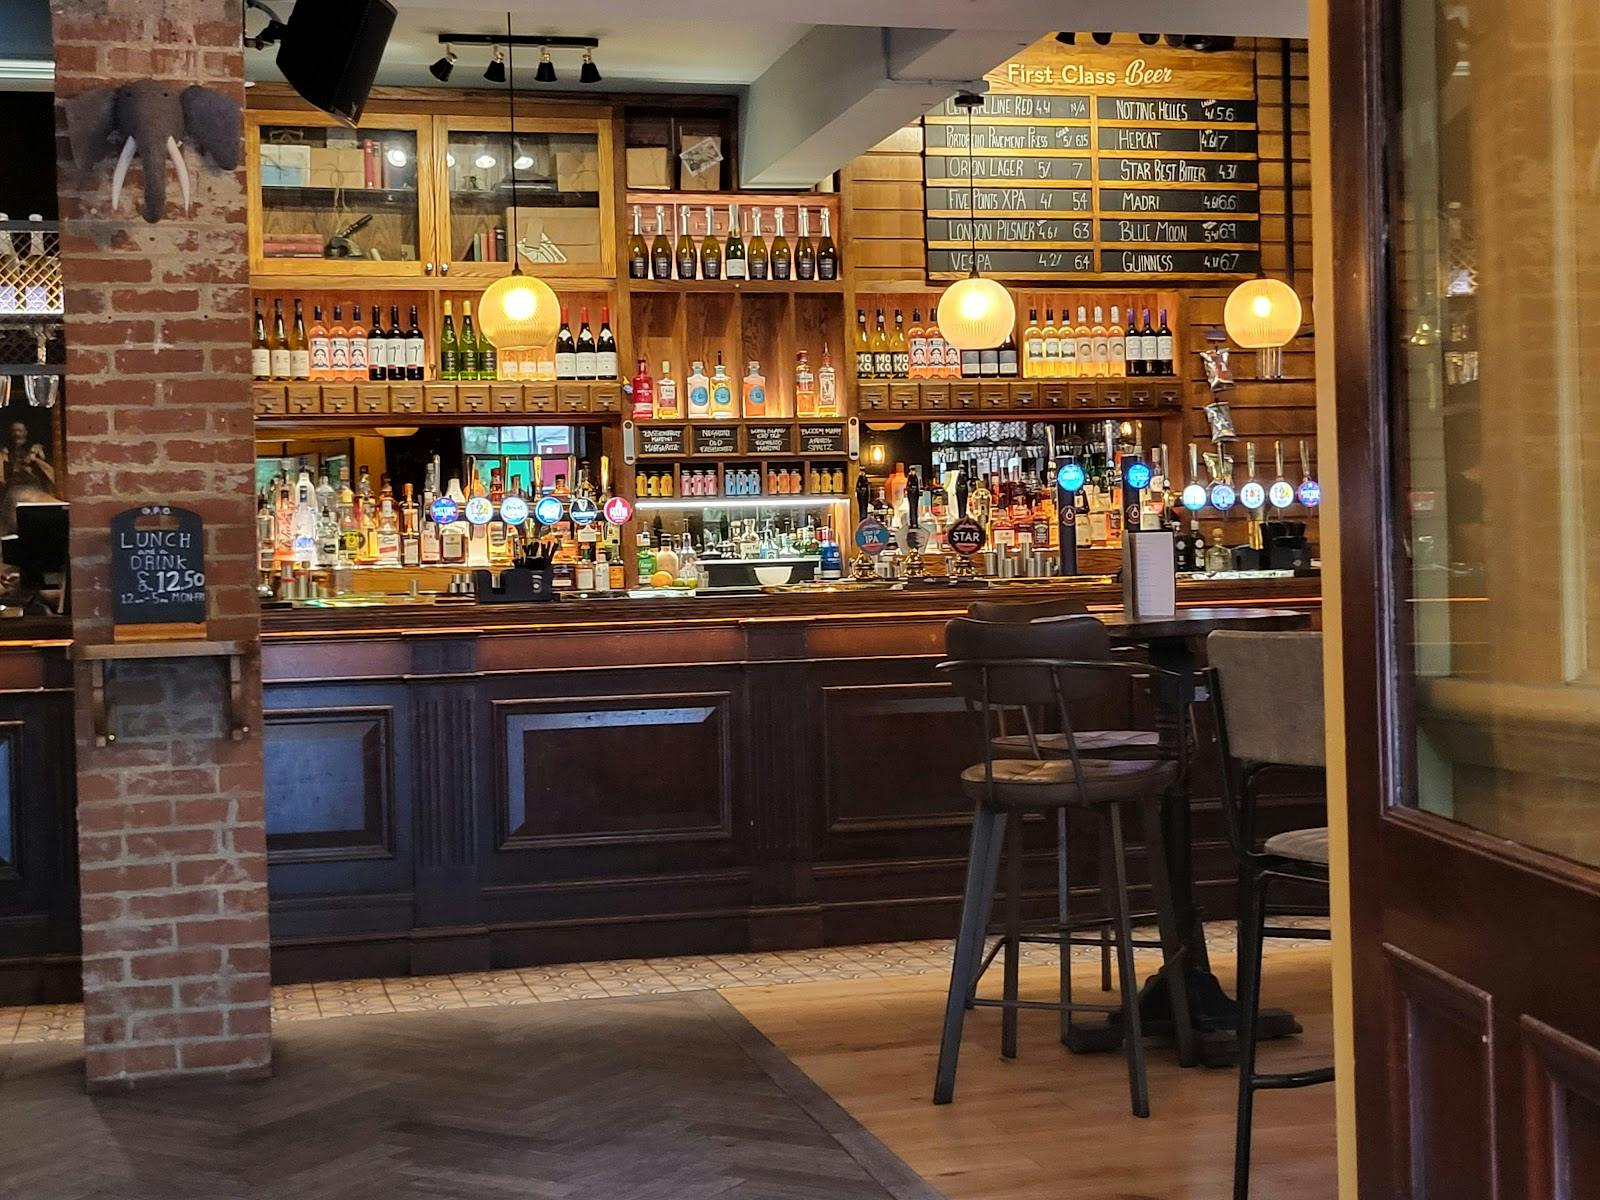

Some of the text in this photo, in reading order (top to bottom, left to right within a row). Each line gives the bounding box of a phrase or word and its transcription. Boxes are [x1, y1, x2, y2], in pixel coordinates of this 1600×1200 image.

[1008, 59, 1173, 86] First Class Beer
[991, 96, 1011, 115] LINE
[1015, 96, 1033, 116] RED
[1070, 100, 1086, 116] N/A
[1116, 99, 1156, 120] NOTTING
[1119, 130, 1161, 150] HEPCAT
[990, 158, 1023, 176] LAGER
[1072, 163, 1082, 179] 7
[1120, 159, 1152, 180] STAR
[1155, 159, 1177, 182] BEST
[949, 189, 969, 209] FIVE
[1002, 190, 1027, 209] XPA
[1122, 192, 1160, 211] MADRI
[949, 220, 992, 241] LONDON
[997, 220, 1035, 240] PILSNER
[1118, 220, 1152, 242] BLUE
[1155, 221, 1188, 242] MOON
[1122, 251, 1174, 272] GUINNESS
[121, 532, 191, 549] LUNCH
[865, 535, 879, 544] IPA
[953, 531, 980, 542] STAR
